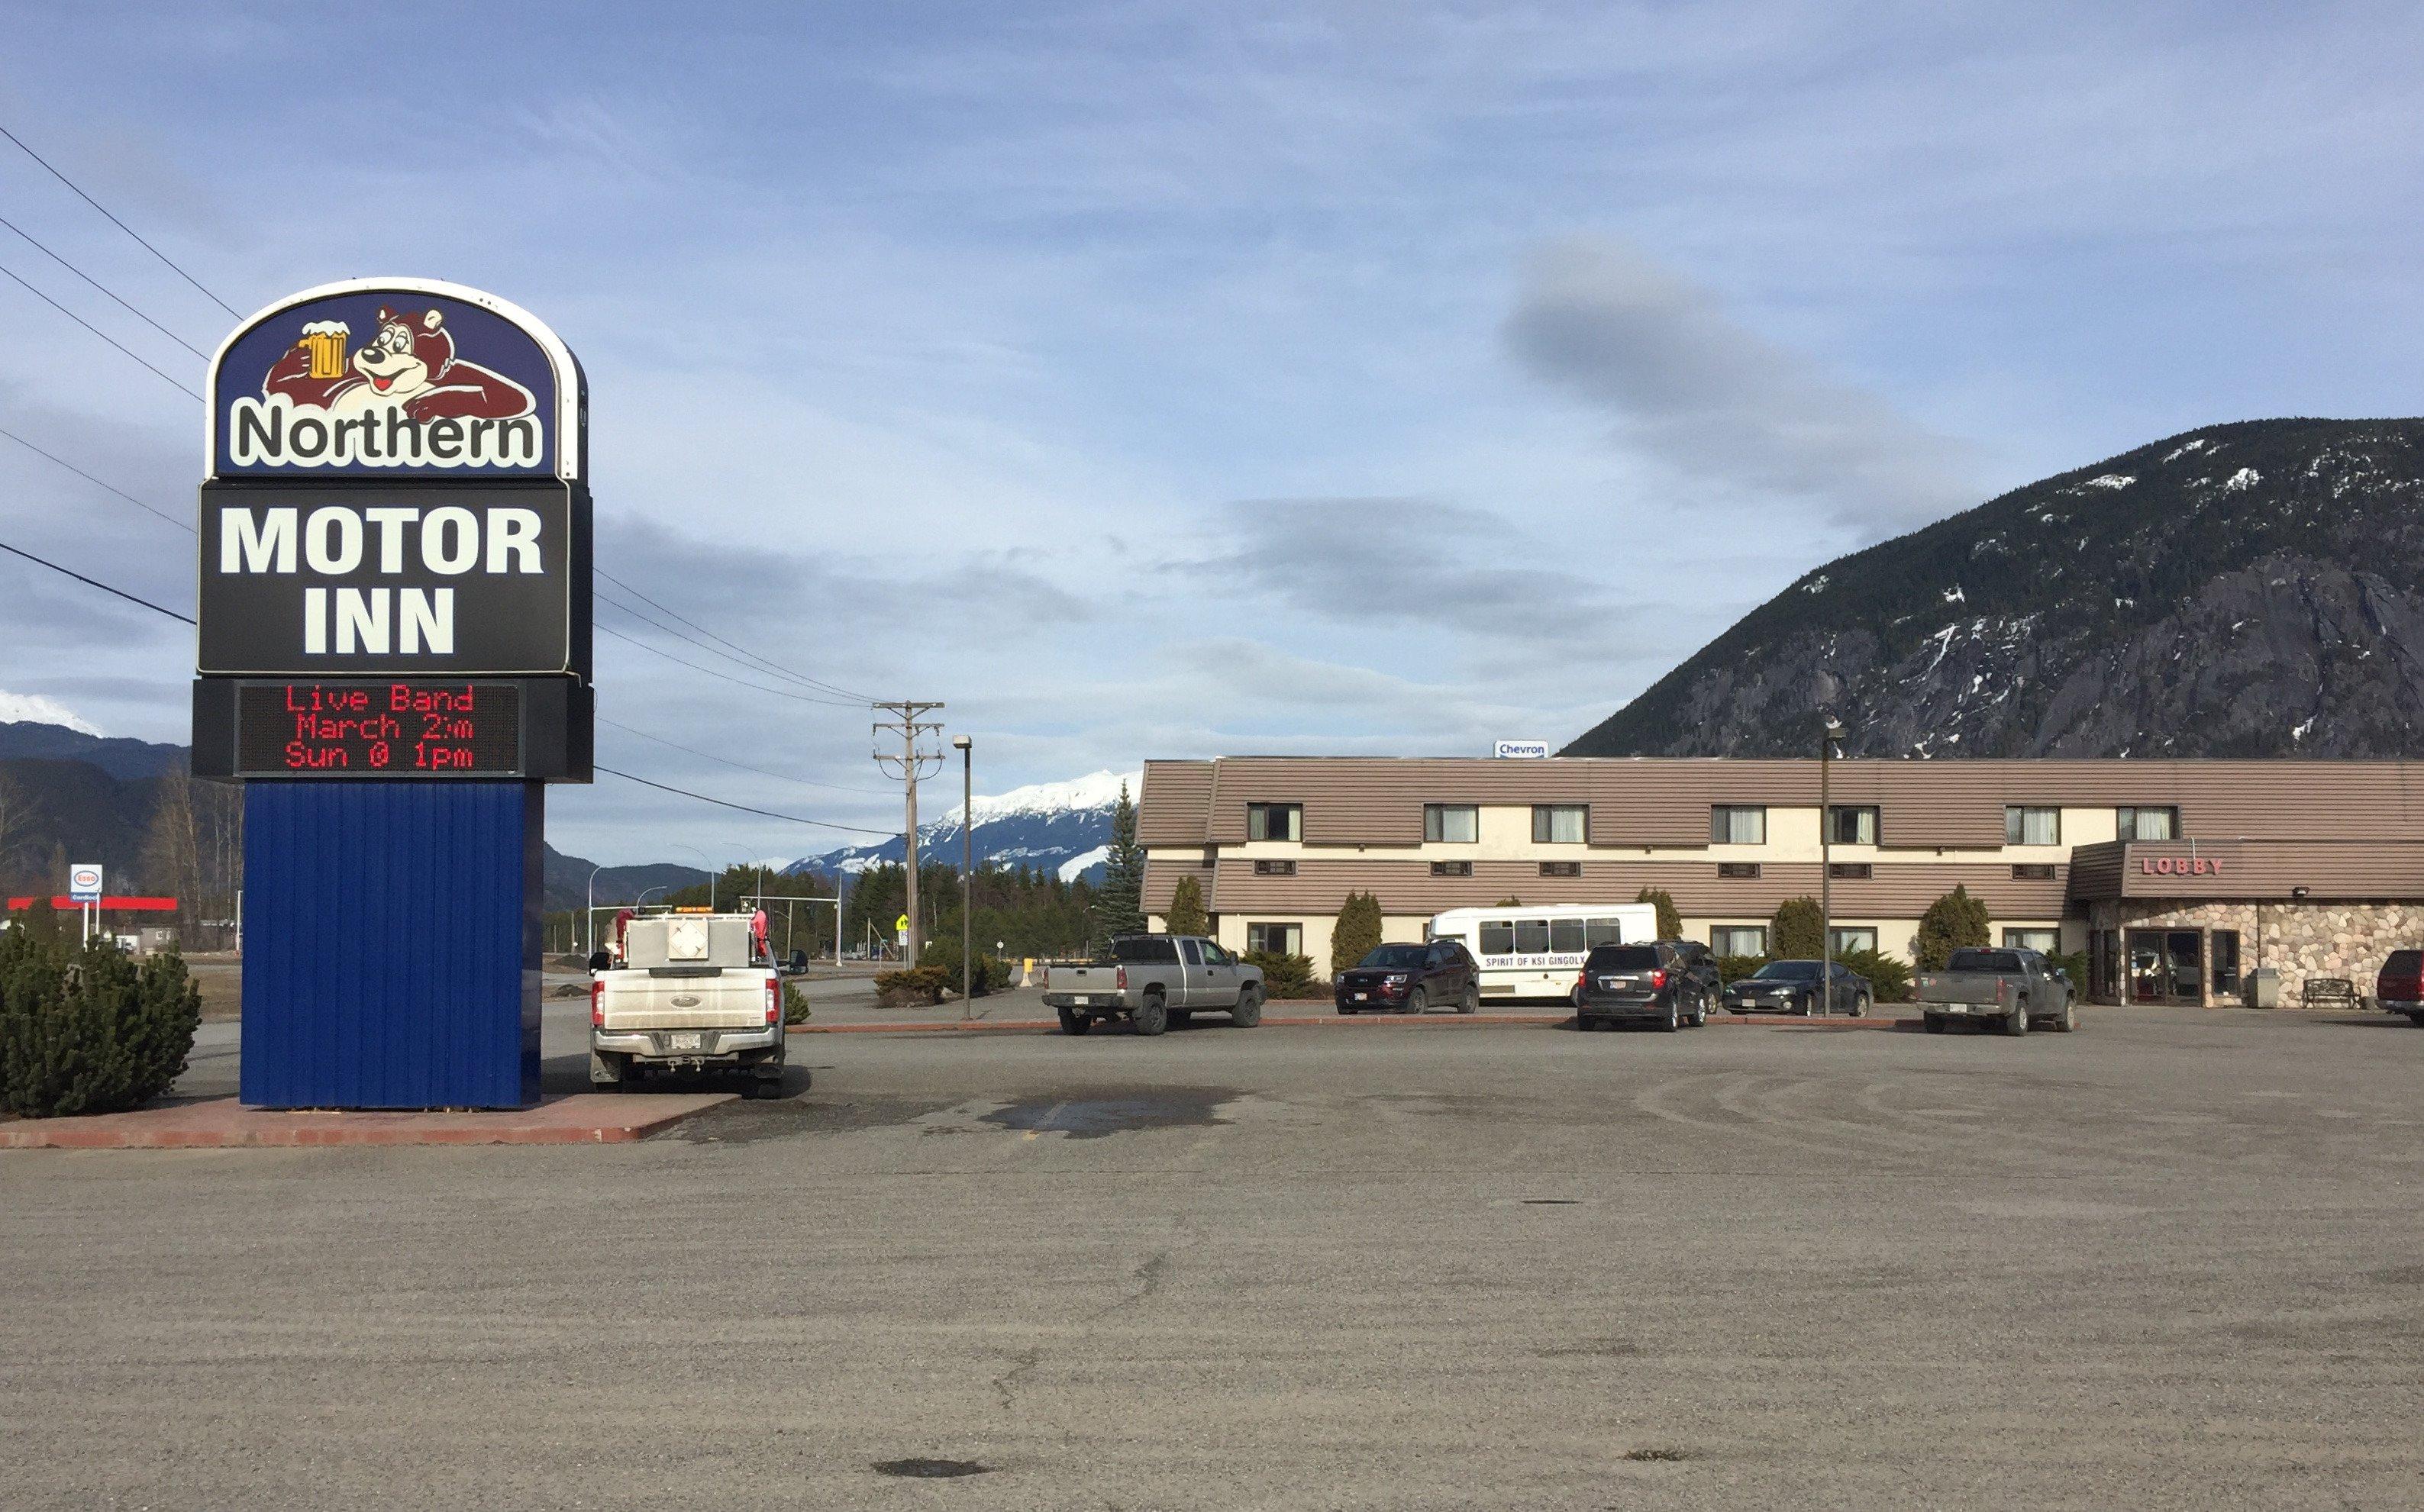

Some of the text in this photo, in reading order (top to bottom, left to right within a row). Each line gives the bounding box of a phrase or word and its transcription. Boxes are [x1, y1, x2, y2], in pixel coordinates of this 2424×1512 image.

[237, 405, 534, 459] Northern
[220, 506, 544, 574] MOTOR
[305, 587, 454, 654] INN
[286, 684, 473, 711] Live Band
[297, 713, 401, 739] March
[286, 740, 473, 771] Sun @ 1pm
[1499, 743, 1544, 754] Chevron
[2142, 857, 2223, 875] LOBBY
[1486, 957, 1514, 967] SPIRIT
[1517, 956, 1528, 966] OF
[1532, 956, 1545, 966] KSI
